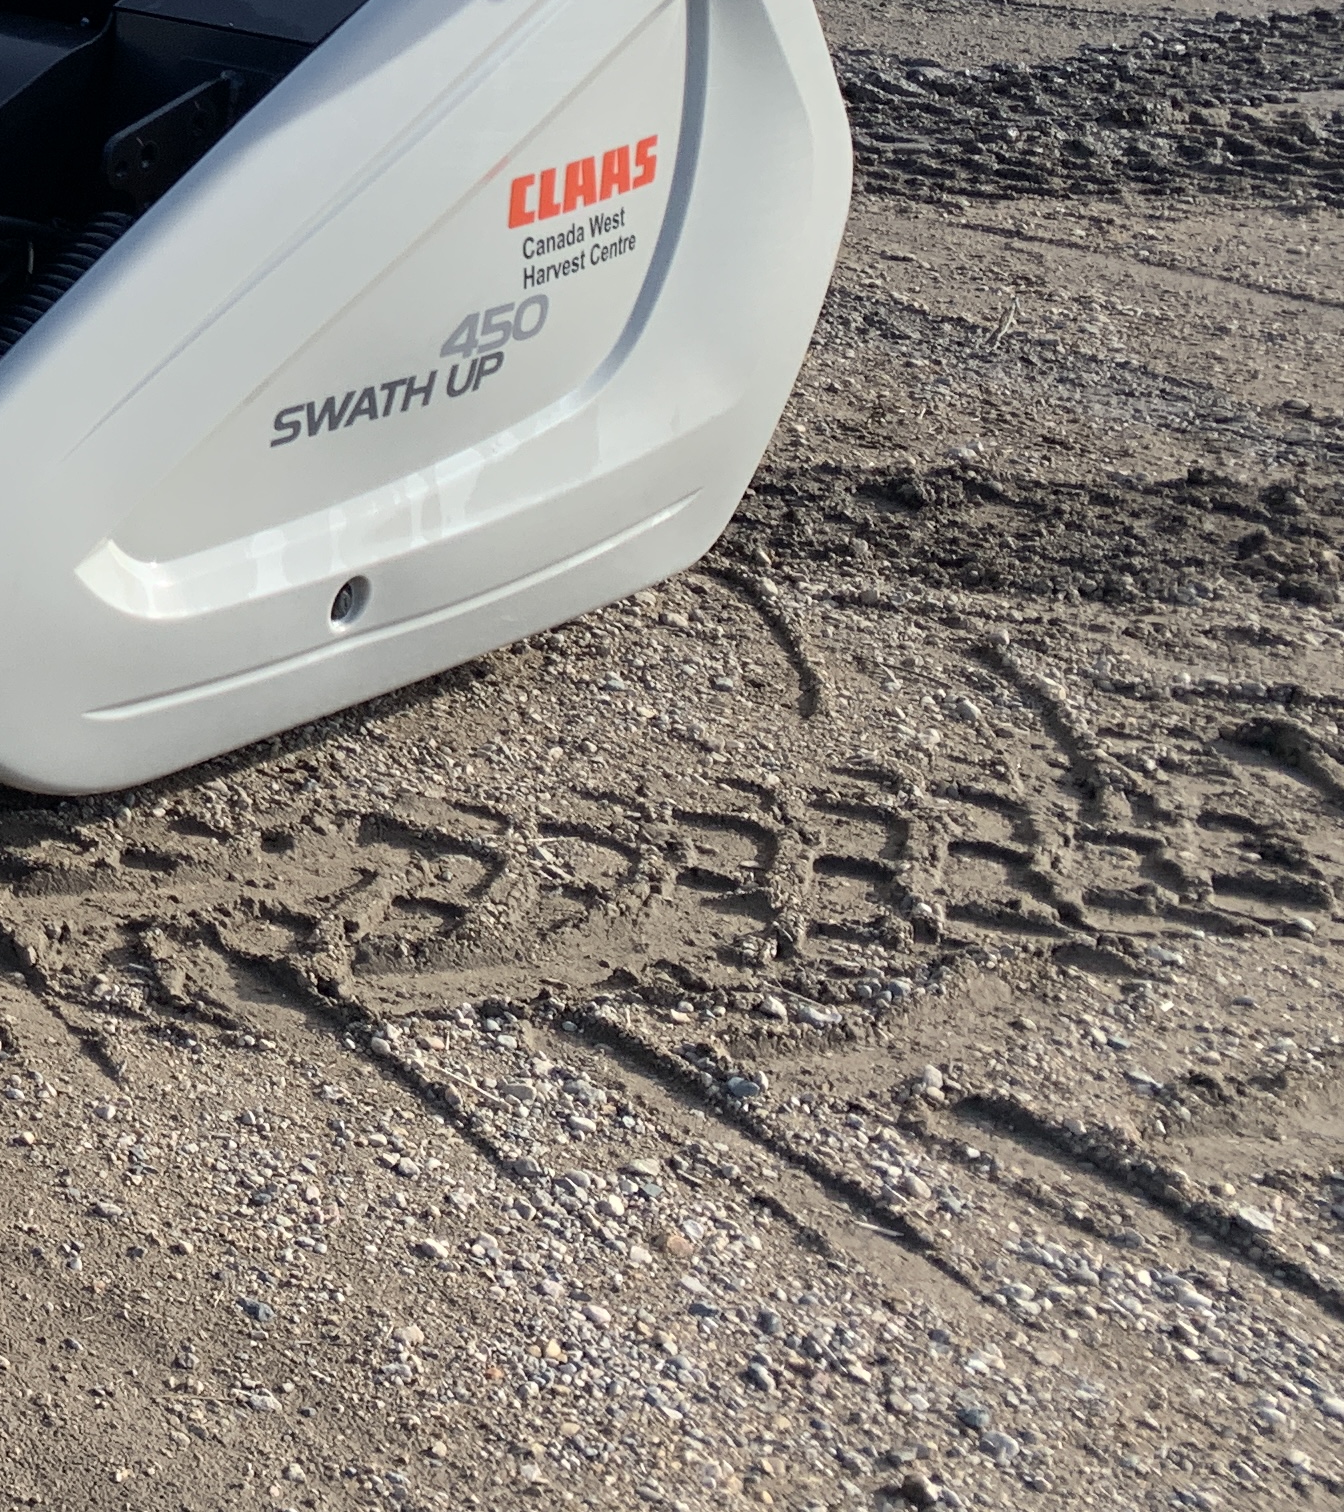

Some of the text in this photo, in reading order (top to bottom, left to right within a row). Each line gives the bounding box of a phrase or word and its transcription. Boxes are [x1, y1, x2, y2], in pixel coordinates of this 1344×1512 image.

[508, 134, 658, 229] CLAAS
[522, 206, 626, 260] Canada West
[523, 233, 637, 290] Harvest Centre
[439, 293, 550, 359] 450
[269, 350, 505, 448] SWATH UP
